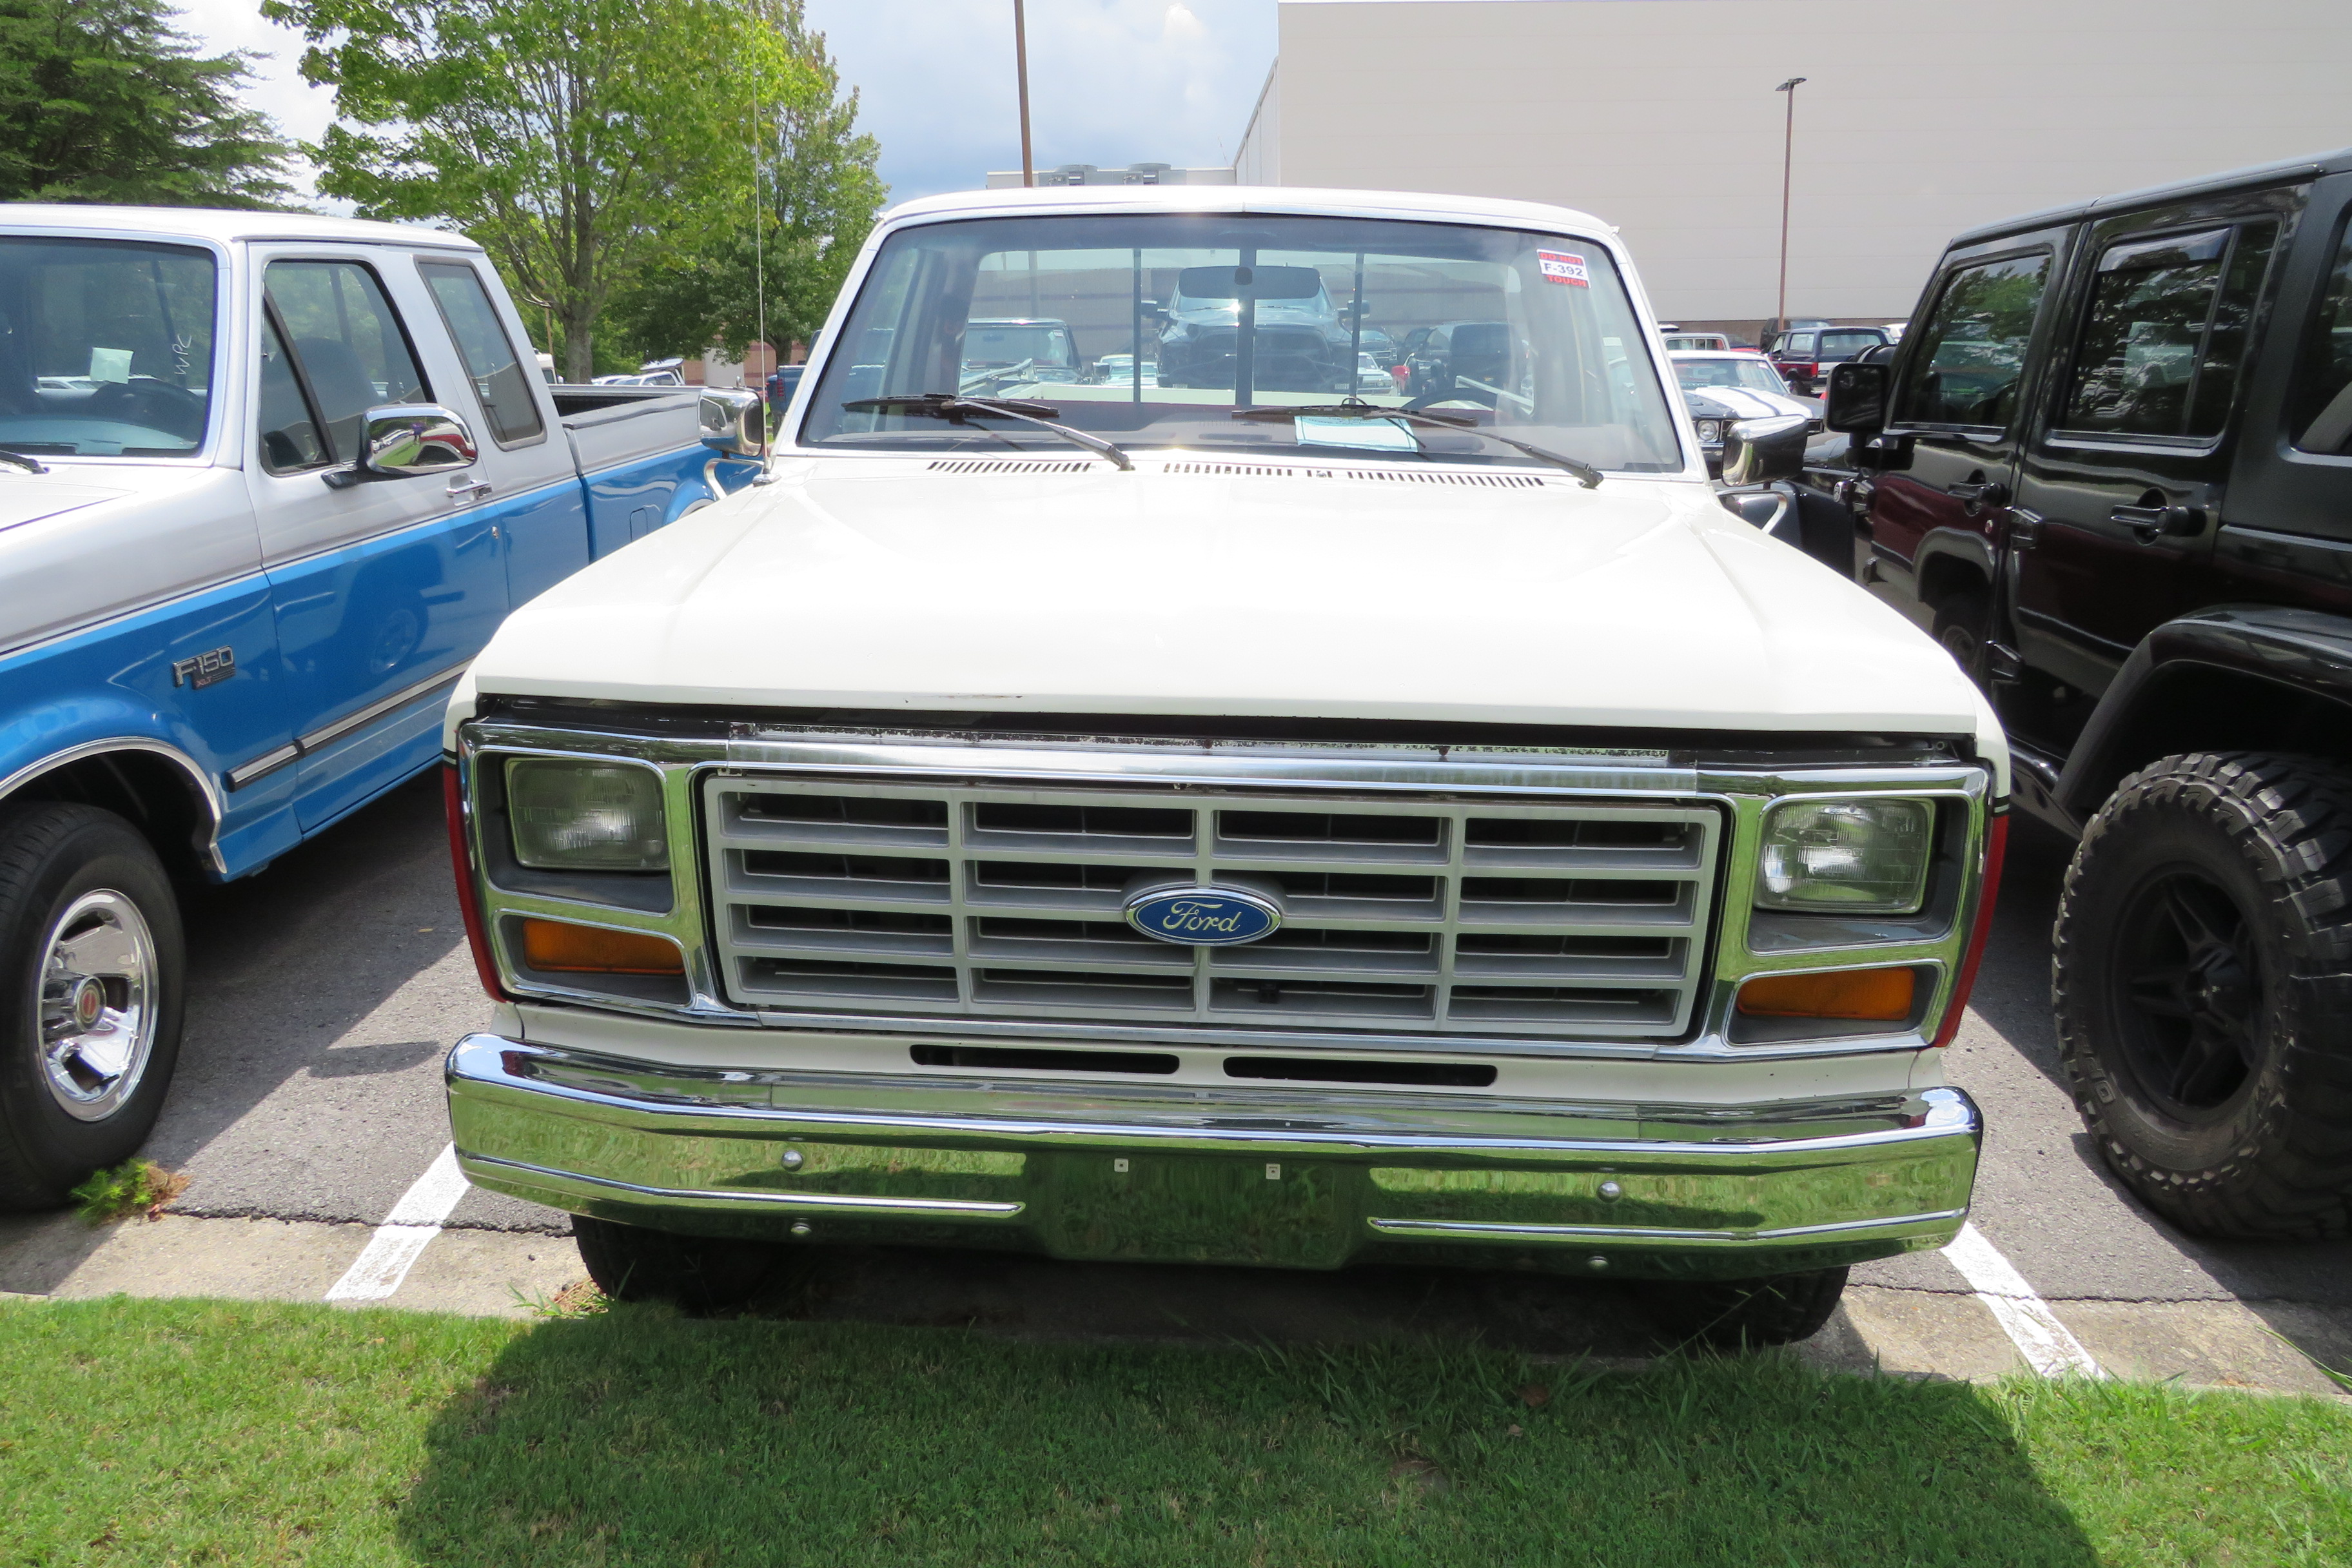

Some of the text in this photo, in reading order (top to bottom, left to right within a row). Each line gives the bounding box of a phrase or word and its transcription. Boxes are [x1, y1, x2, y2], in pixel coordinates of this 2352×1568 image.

[1539, 252, 1583, 264] DO NOT
[1544, 263, 1584, 277] F-392
[1548, 275, 1587, 287] TOUCH
[1162, 901, 1242, 932] Ford
